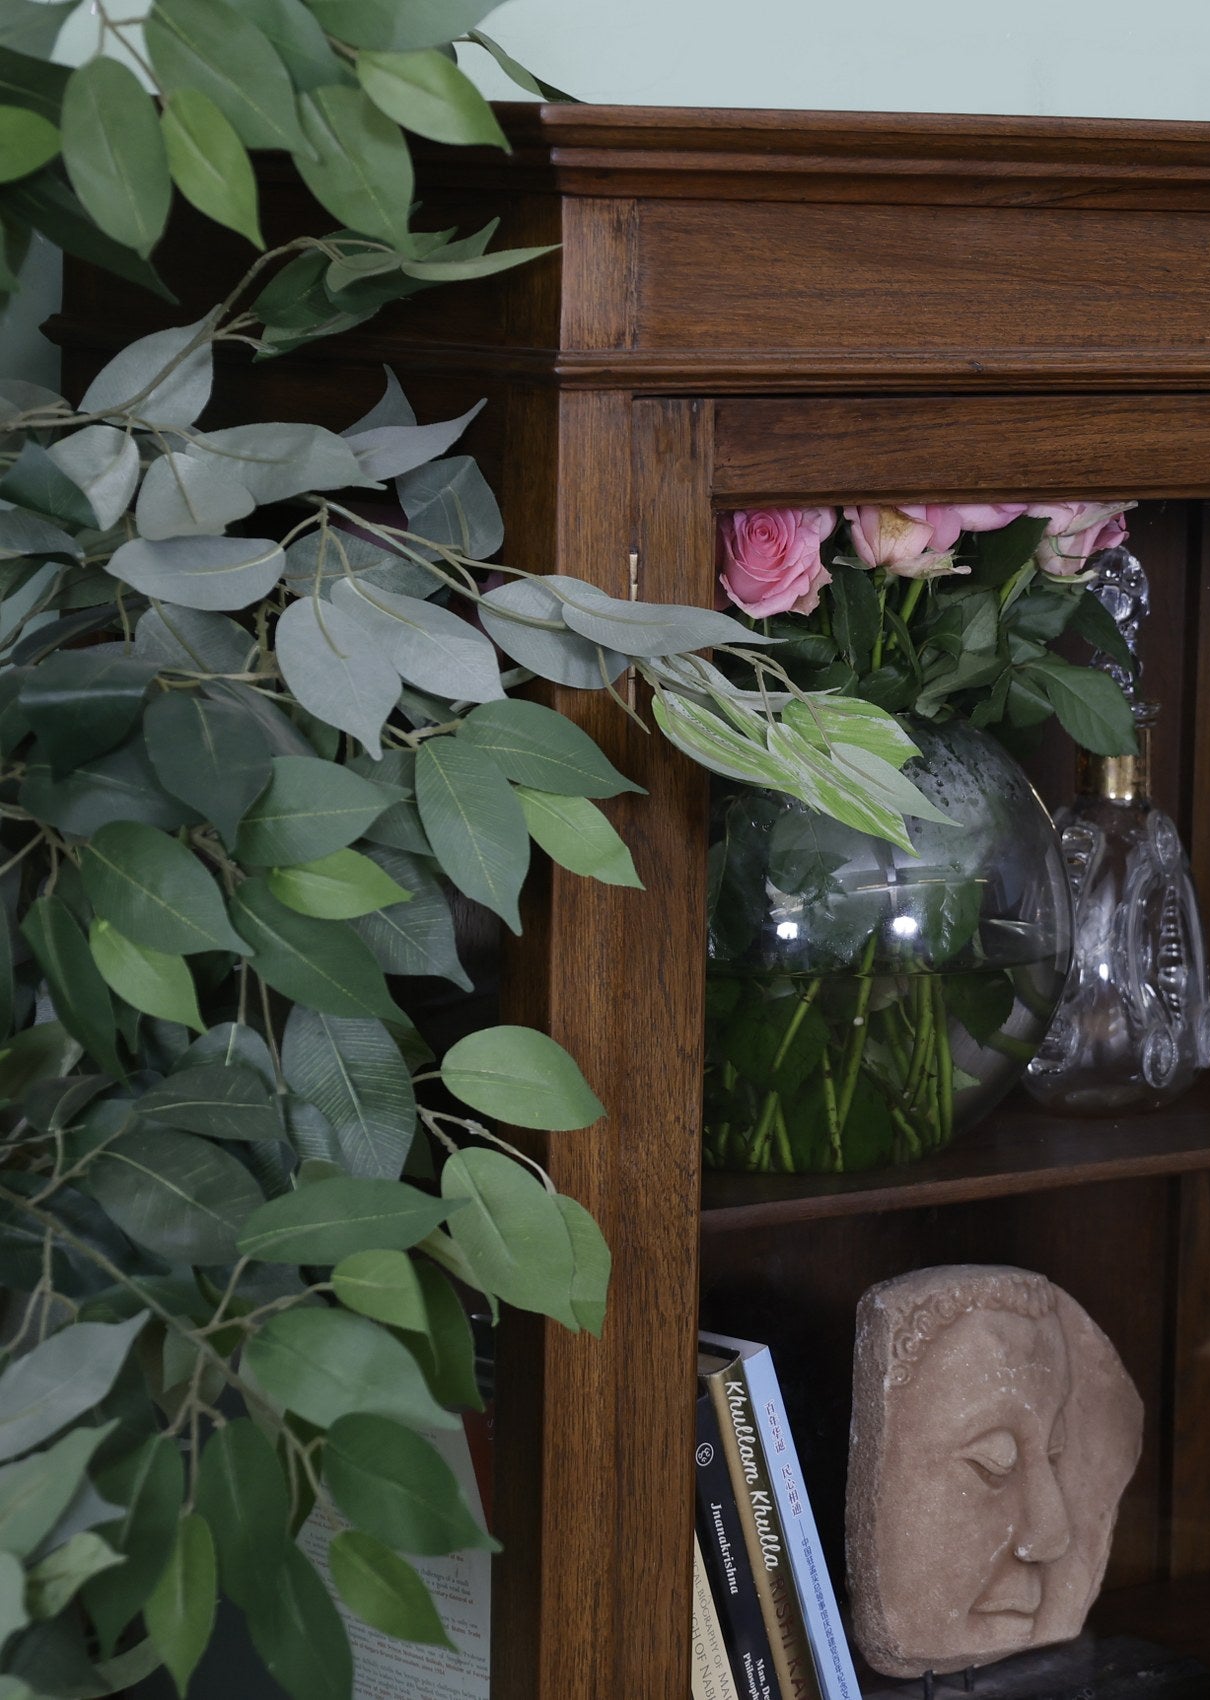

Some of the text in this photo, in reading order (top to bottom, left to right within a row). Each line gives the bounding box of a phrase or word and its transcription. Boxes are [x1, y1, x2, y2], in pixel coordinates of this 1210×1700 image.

[725, 1381, 781, 1572] Khullam Khulla
[710, 1501, 739, 1595] Jnanakrishna
[692, 1612, 700, 1639] GH
[695, 1643, 707, 1662] OF
[697, 1589, 719, 1652] BIOGRAPHY
[713, 1655, 723, 1670] OF
[769, 1575, 808, 1700] RISHI KA
[755, 1657, 767, 1686] Man,
